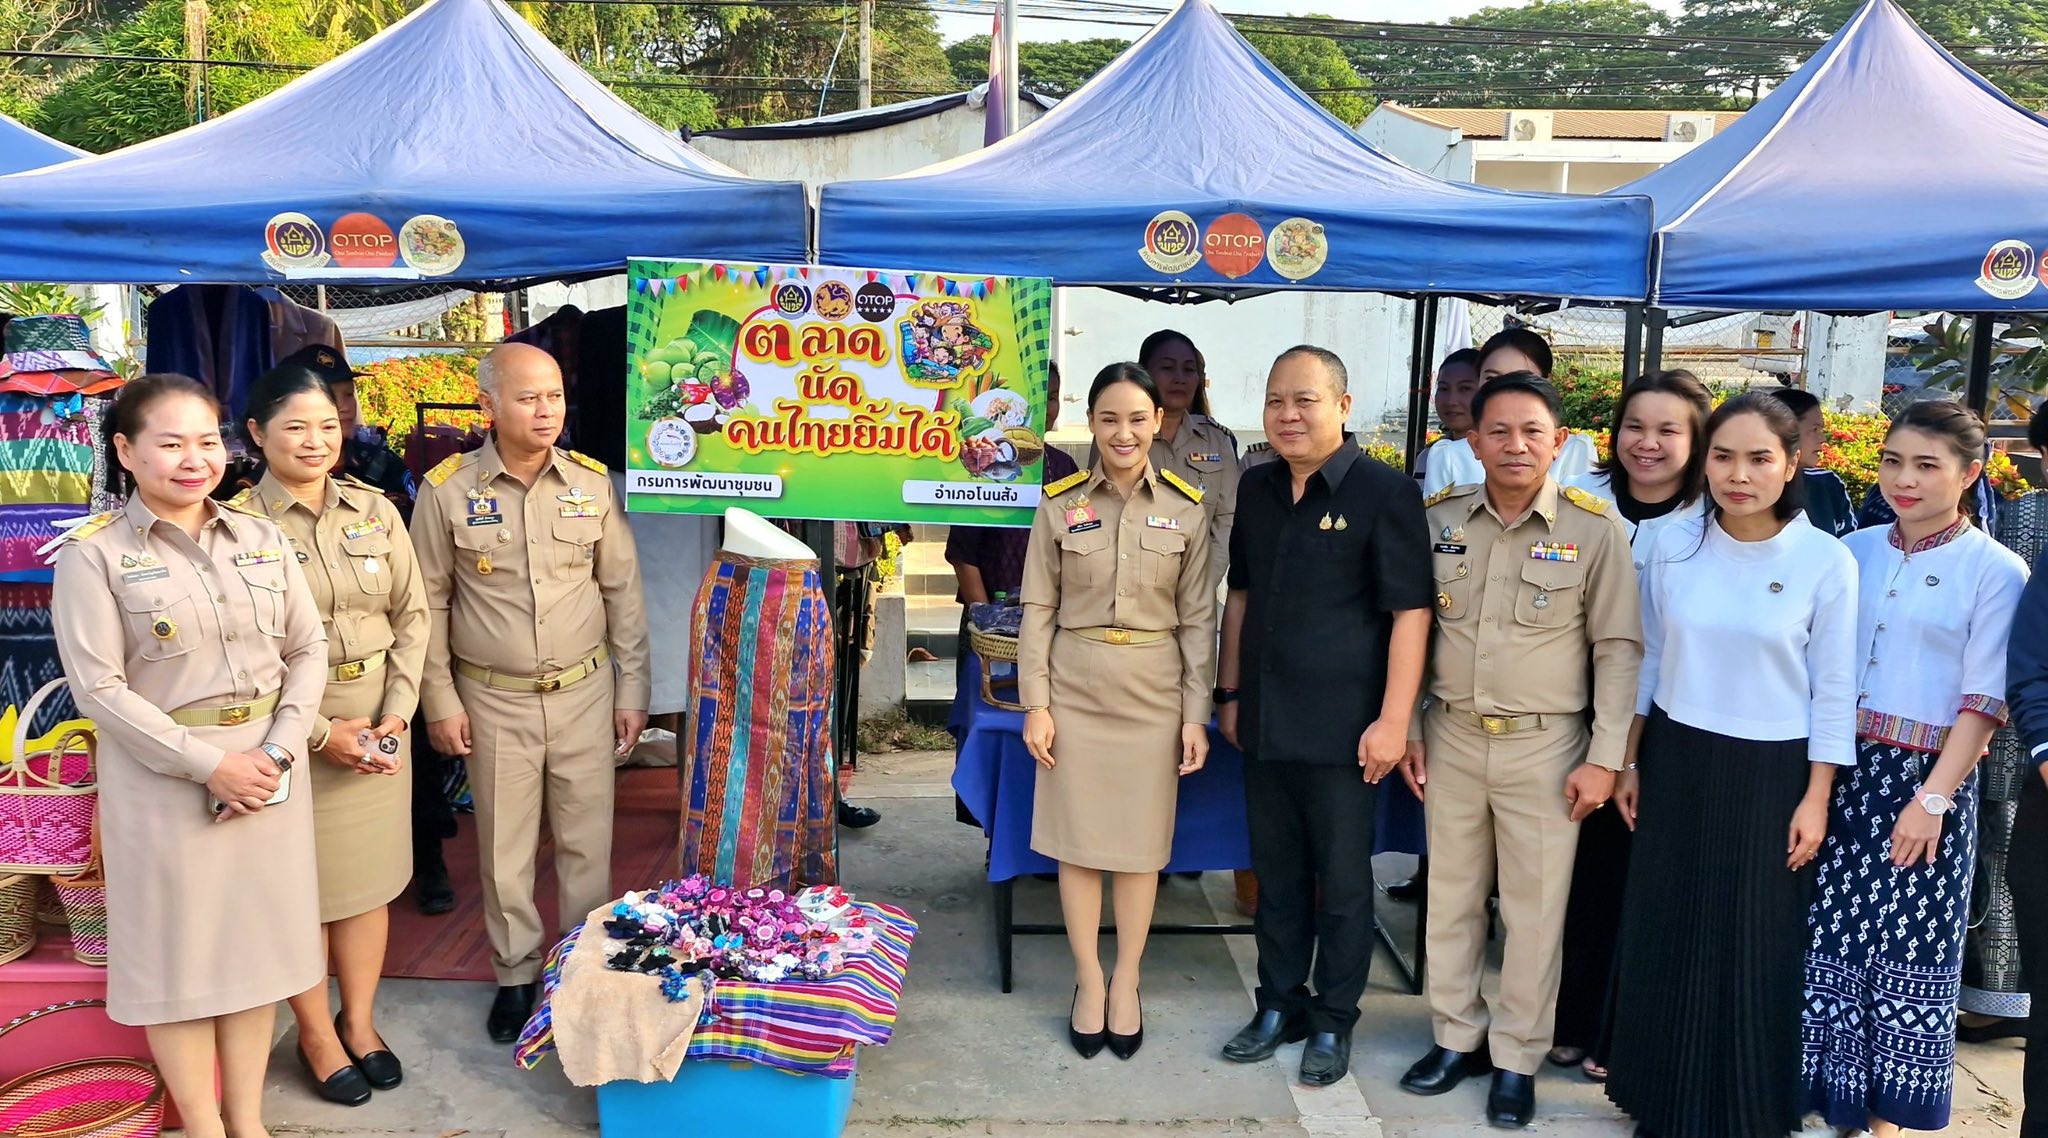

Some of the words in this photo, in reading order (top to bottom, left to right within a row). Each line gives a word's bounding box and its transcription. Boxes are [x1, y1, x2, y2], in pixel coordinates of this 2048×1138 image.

[333, 233, 393, 247] OTOP
[1206, 233, 1262, 248] OTOP
[857, 294, 893, 305] OTOP
[800, 364, 862, 407] นัด
[727, 402, 956, 458] คนไทยยิ้มได้
[637, 473, 773, 497] กรมการพัฒนาชุมชน
[934, 483, 1018, 502] อำเภอโนนสัง
